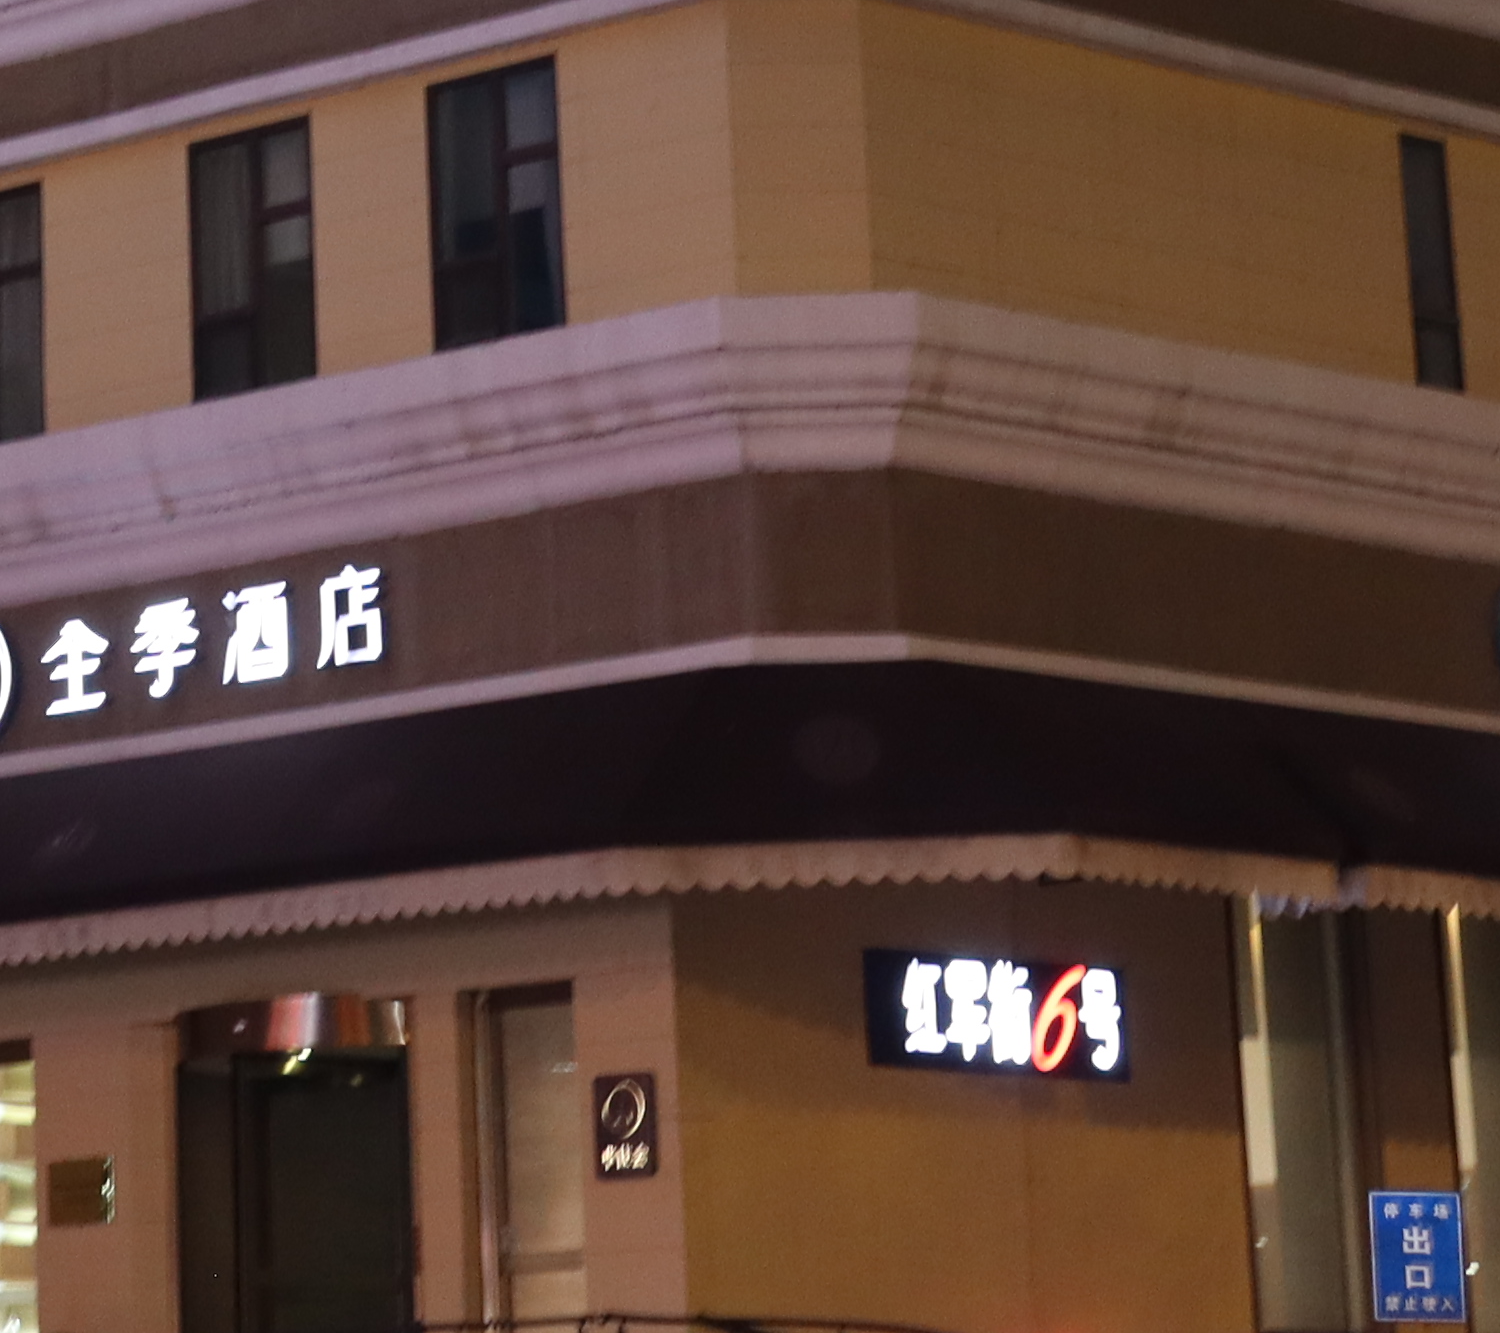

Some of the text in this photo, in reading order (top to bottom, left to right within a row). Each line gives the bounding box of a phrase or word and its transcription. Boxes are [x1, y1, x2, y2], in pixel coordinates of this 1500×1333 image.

[40, 563, 384, 717] 全季酒店
[1383, 1202, 1451, 1220] 停车场
[1402, 1225, 1433, 1290] 出口
